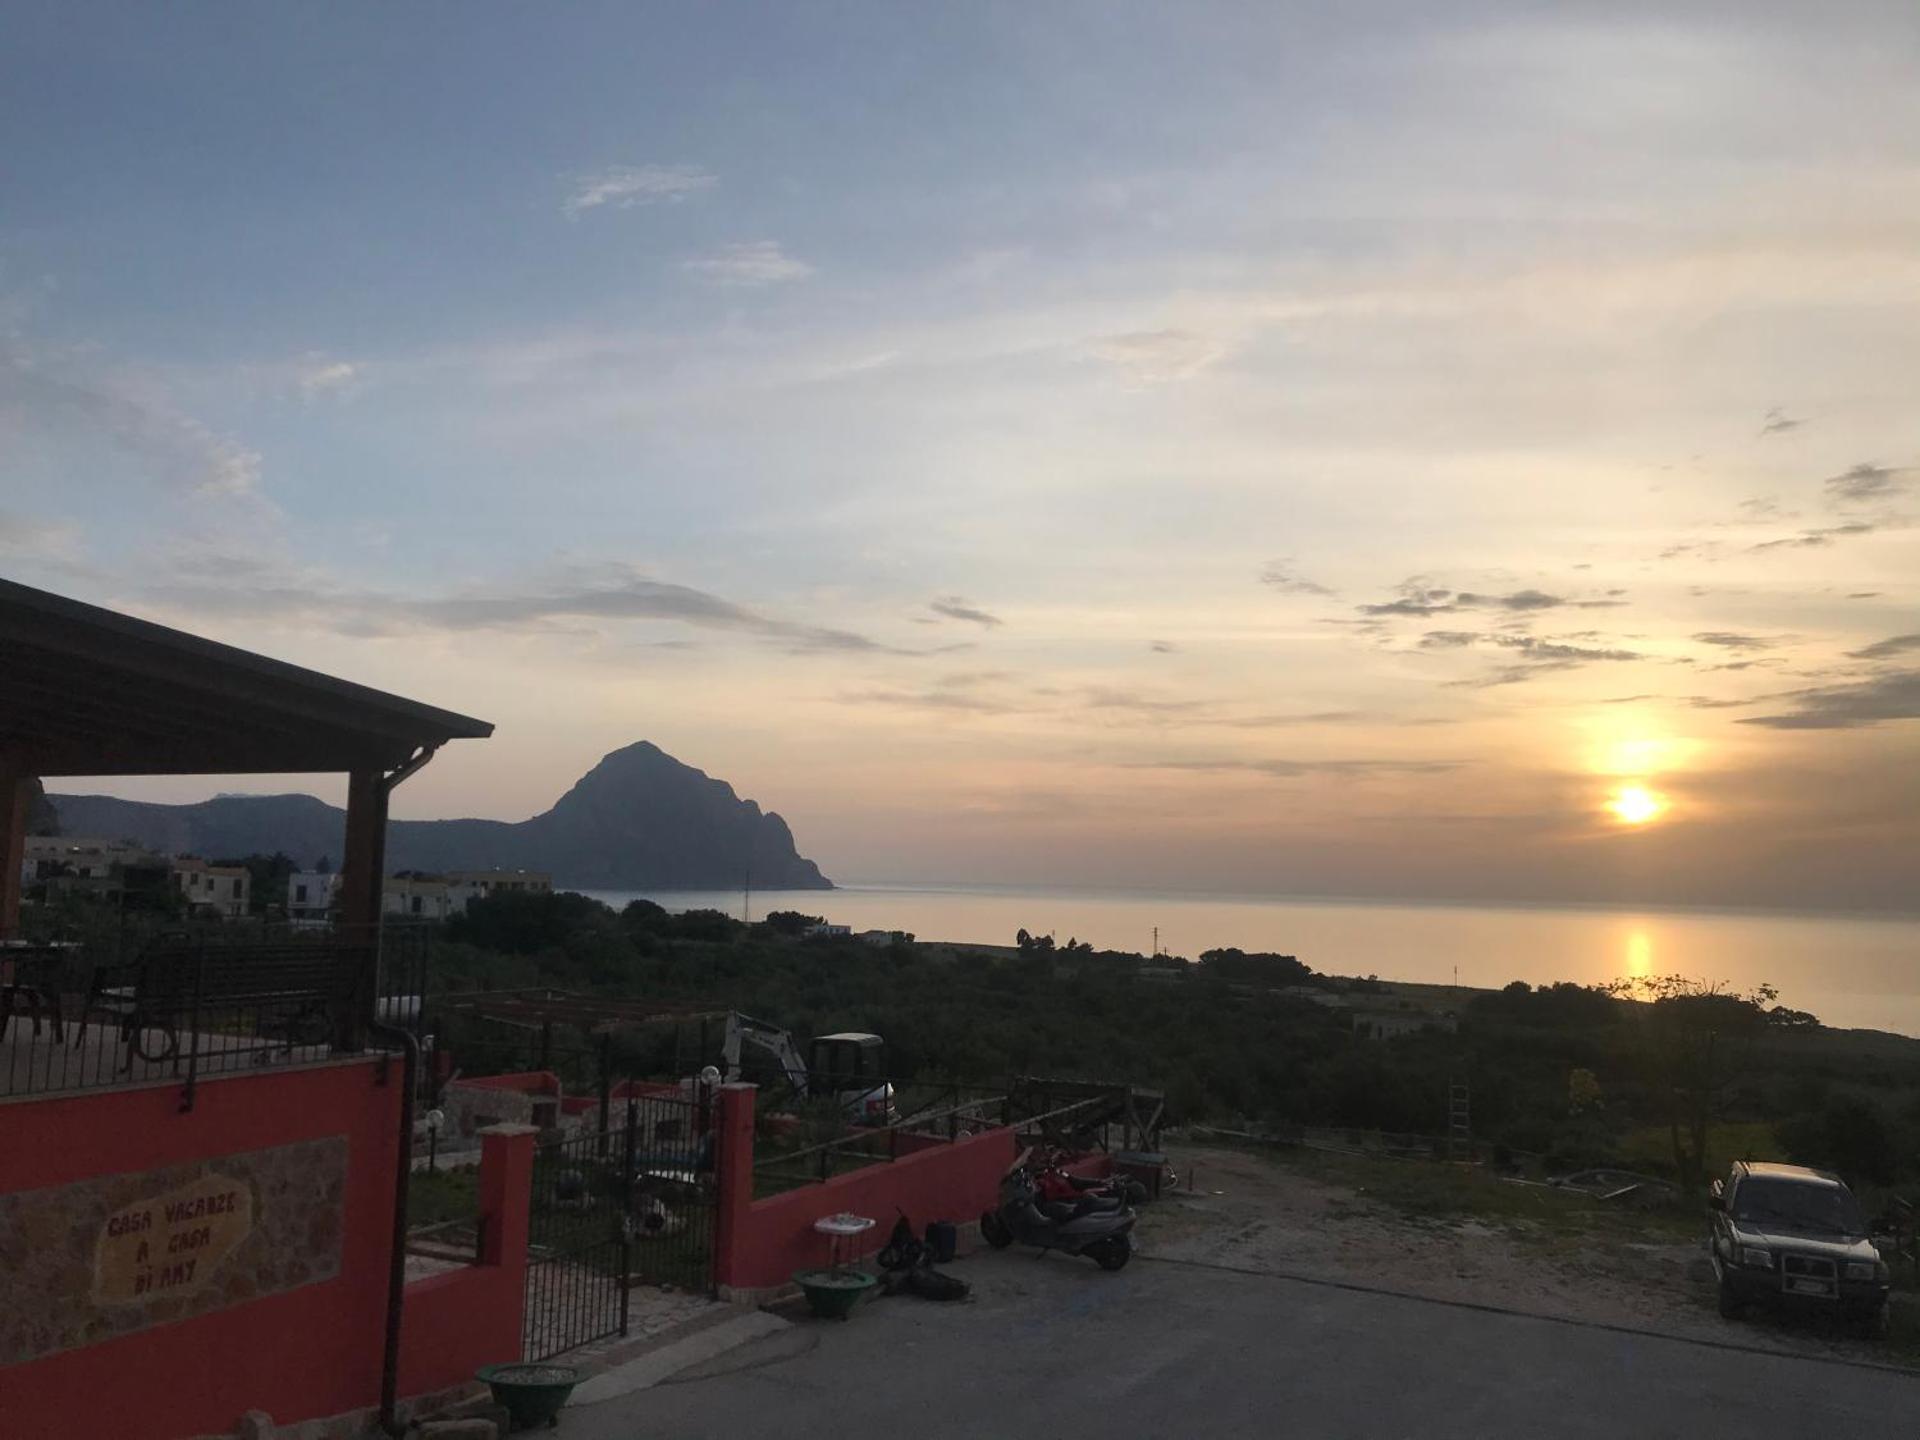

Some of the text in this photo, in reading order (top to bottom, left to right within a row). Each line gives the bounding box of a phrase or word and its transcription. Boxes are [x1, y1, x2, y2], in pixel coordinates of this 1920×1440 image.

[108, 1211, 150, 1237] CASA
[136, 1227, 210, 1263] A CASA
[160, 1259, 196, 1287] AMY
